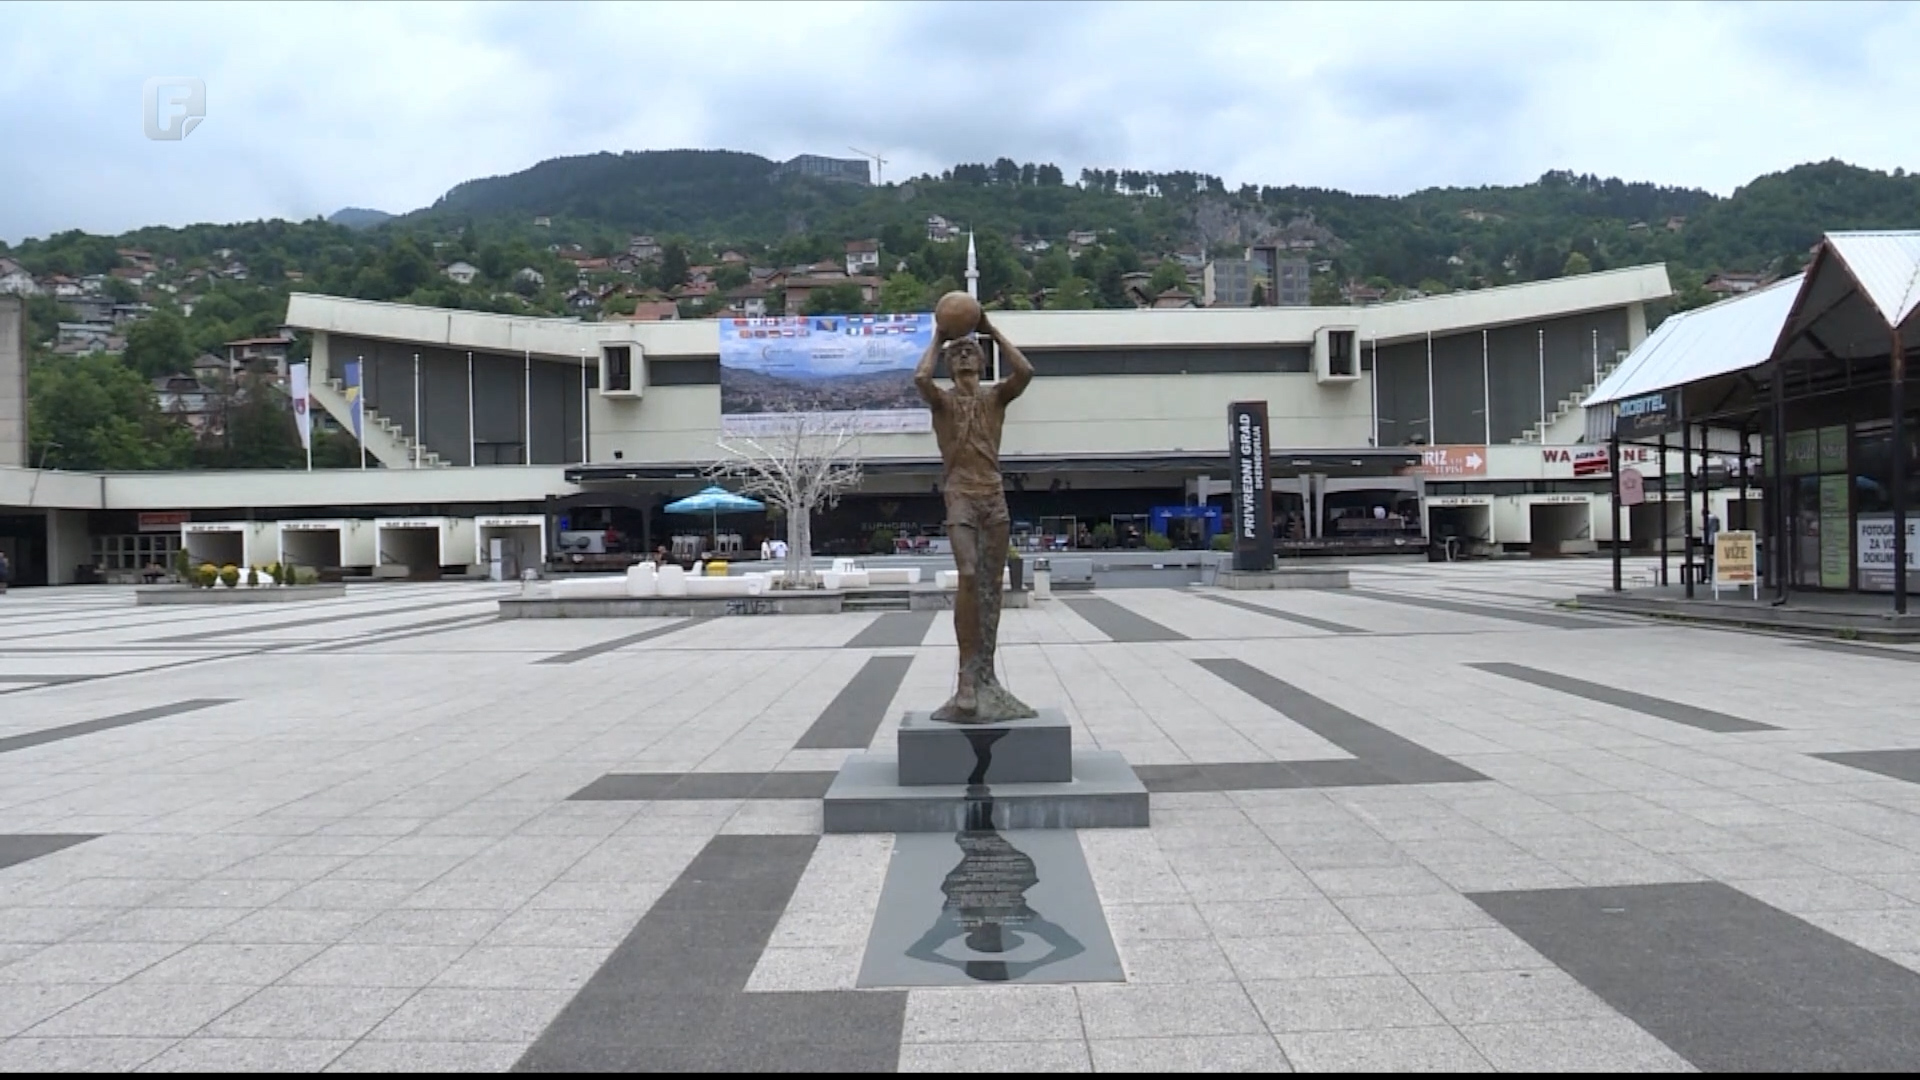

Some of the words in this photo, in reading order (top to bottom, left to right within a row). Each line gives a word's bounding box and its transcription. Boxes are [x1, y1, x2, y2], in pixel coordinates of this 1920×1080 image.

[1239, 413, 1252, 455] GRAD
[1252, 425, 1263, 490] SKENDERIJA
[1241, 458, 1255, 539] PRIVREDNI
[1861, 523, 1915, 536] FOTOGRJE
[1869, 538, 1881, 549] ZA
[1883, 538, 1897, 549] VIZ
[1723, 546, 1748, 559] VIZE
[1863, 552, 1914, 565] DOKUMTE
